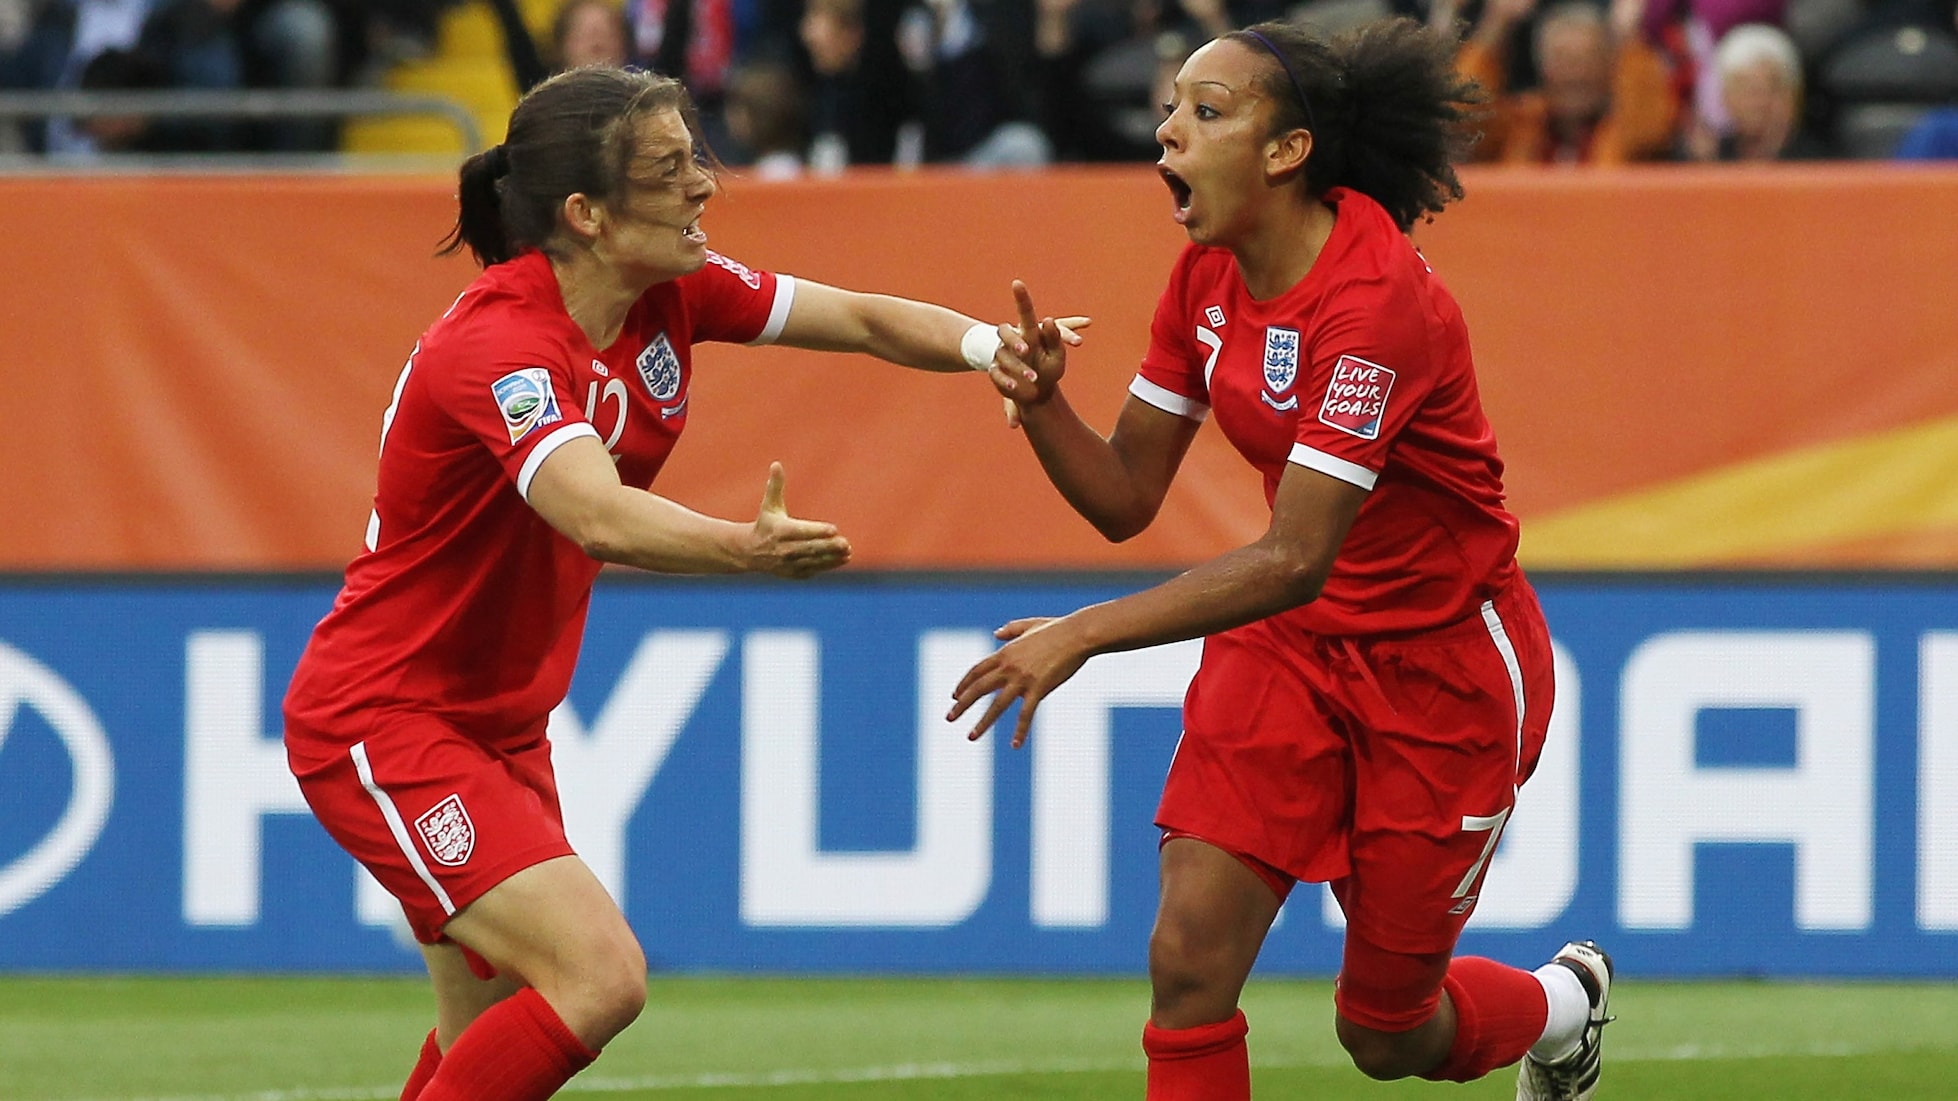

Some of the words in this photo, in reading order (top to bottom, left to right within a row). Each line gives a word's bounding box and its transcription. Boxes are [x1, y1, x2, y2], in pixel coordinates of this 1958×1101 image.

[1196, 325, 1223, 392] 7
[1338, 365, 1380, 382] LIVE
[1333, 382, 1381, 400] YOUR
[1326, 398, 1382, 416] GOALS
[537, 414, 560, 428] FIFA
[584, 378, 628, 464] 12
[1450, 806, 1510, 898] 7
